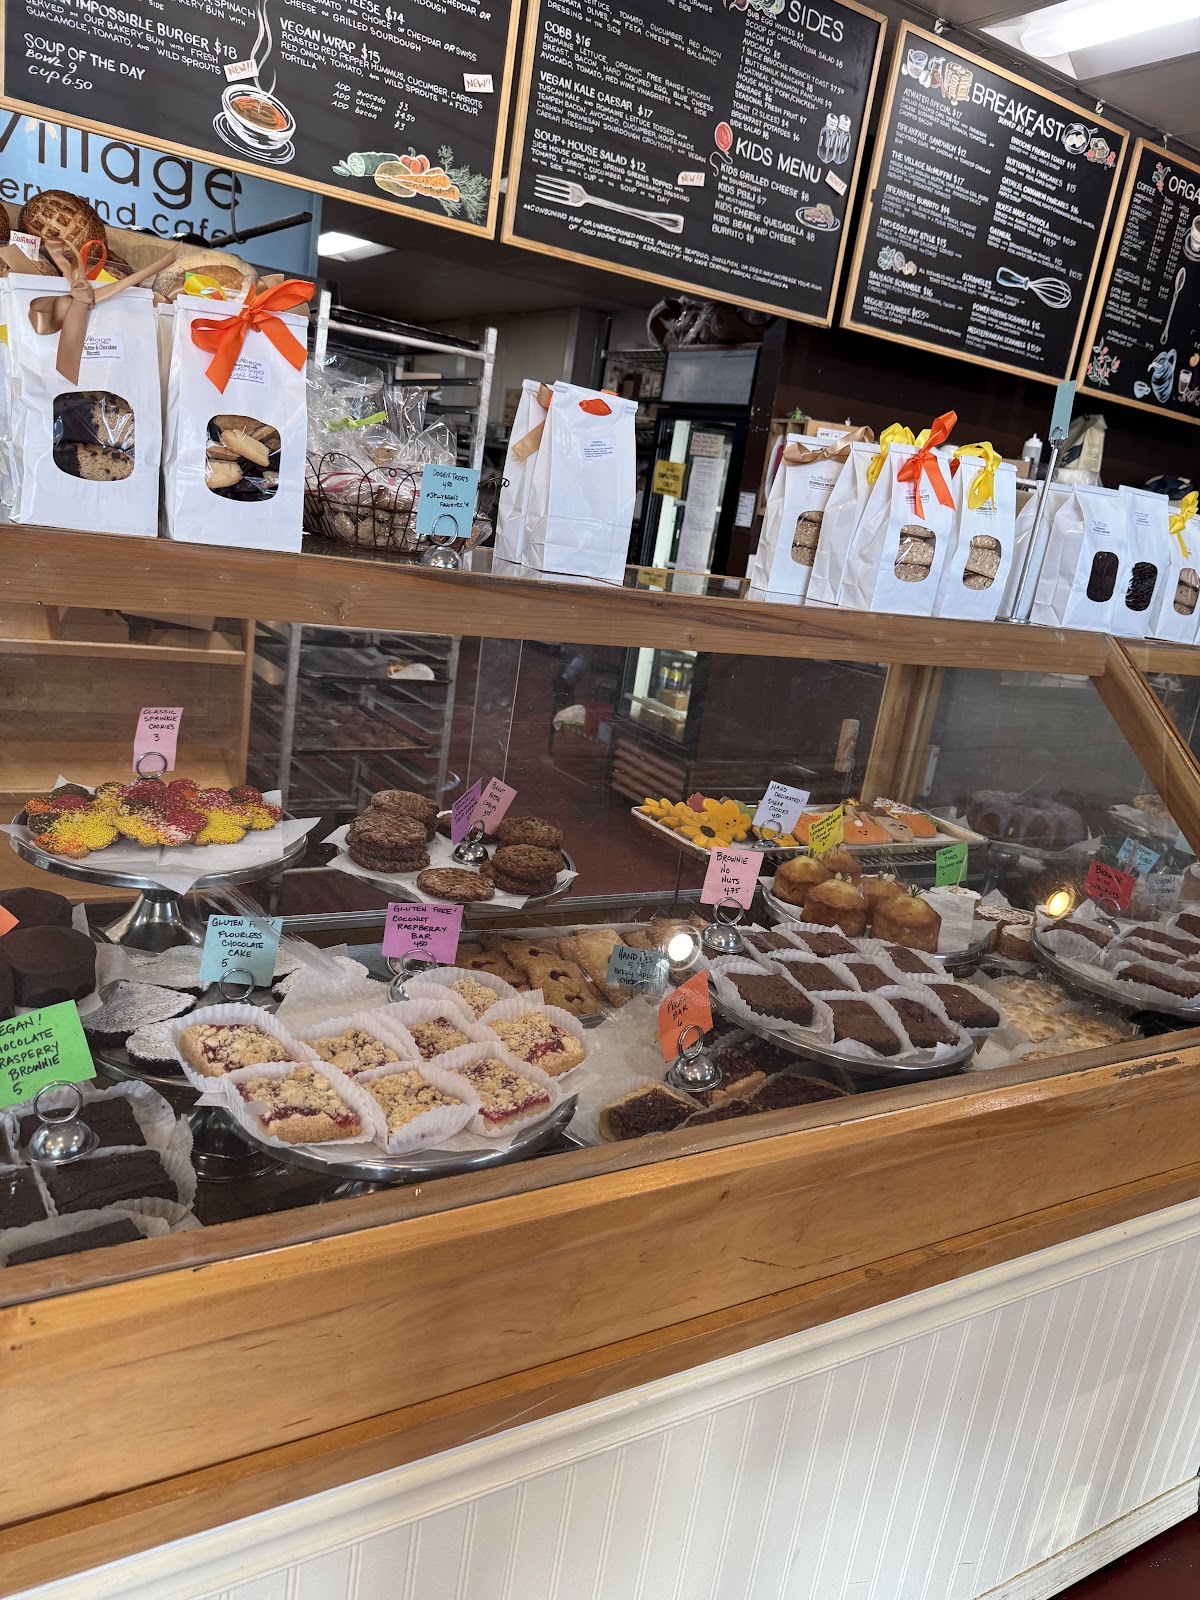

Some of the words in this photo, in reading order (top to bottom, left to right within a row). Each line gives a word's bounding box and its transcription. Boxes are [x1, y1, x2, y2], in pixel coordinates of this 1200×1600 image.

[212, 0, 256, 20] SPINACH
[76, 0, 154, 32] IMPOSSIBLE
[158, 22, 210, 52] BURGER
[214, 37, 238, 60] $18
[788, 0, 844, 42] SIDES
[26, 6, 91, 36] GUACAMOLE,
[92, 26, 134, 48] TOMATO,
[137, 44, 150, 52] AND
[156, 48, 180, 62] WILD
[182, 55, 222, 76] SPROUTS
[84, 14, 104, 28] OUR
[106, 20, 144, 40] BAKERY
[146, 33, 165, 47] BUN
[170, 42, 186, 52] WITH
[191, 48, 219, 64] FRESH
[280, 16, 322, 43] VEGAN
[323, 33, 356, 54] WRAP
[360, 43, 381, 64] $15
[333, 13, 368, 33] GRILLED
[370, 26, 422, 53] SOURDOUGH
[544, 20, 573, 40] COBB
[576, 32, 592, 47] $16
[744, 28, 766, 43] BACON
[766, 36, 774, 47] $5
[24, 32, 66, 56] SOUP
[68, 47, 86, 62] OF
[89, 53, 116, 72] THE
[119, 62, 146, 81] DAY
[280, 50, 318, 70] TORTILLA
[69, 62, 78, 74] 9
[228, 62, 254, 77] NEW!!
[282, 30, 320, 52] ROASTED
[321, 45, 338, 58] RED
[338, 51, 370, 70] PEPPER
[371, 61, 406, 83] HUMMUS,
[408, 74, 450, 99] CUCUMBER,
[450, 91, 483, 110] CARROTS
[62, 73, 93, 91] 6.50
[466, 78, 492, 90] NEW!!
[333, 90, 350, 102] ADD
[356, 97, 384, 114] chicken
[335, 81, 351, 92] ADD
[356, 88, 386, 106] avocado
[398, 101, 410, 112] $3
[540, 71, 573, 93] VEGAN
[574, 82, 596, 99] KALE
[597, 91, 634, 112] CAESAR
[637, 104, 654, 119] $17
[332, 100, 349, 110] ADD
[354, 106, 378, 120] bacon
[394, 120, 406, 132] $3
[972, 82, 1066, 142] BREAKFAST
[998, 116, 1016, 130] SERVED
[1016, 124, 1024, 134] ALL
[1024, 128, 1036, 138] DAY
[567, 138, 598, 159] HOUSE
[599, 148, 628, 166] SALAD
[630, 157, 647, 173] $12
[736, 137, 773, 166] KIDS
[777, 152, 822, 184] MENU
[1032, 146, 1051, 161] FRENCH
[1052, 154, 1066, 167] TOAST
[892, 150, 904, 161] THE
[904, 155, 926, 171] VILLAGE
[954, 174, 966, 186] $17
[720, 162, 738, 176] KIDS
[740, 170, 770, 188] GRILLED
[770, 181, 799, 198] CHEESE
[800, 190, 810, 202] $8
[1136, 181, 1156, 197] COFFEE
[1168, 176, 1200, 205] ORGA
[718, 181, 735, 195] KIDS
[736, 188, 756, 202] PB&J
[756, 194, 768, 206] $7
[713, 213, 730, 226] KIDS
[732, 218, 752, 232] BEAN
[752, 225, 768, 236] AND
[768, 230, 797, 246] CHEESE
[714, 200, 732, 213] KIDS
[733, 207, 762, 222] CHEESE
[763, 216, 804, 237] QUESADILLA
[806, 231, 816, 242] $8
[712, 224, 744, 240] BURRITO
[746, 232, 755, 244] $8
[154, 733, 160, 742] 3
[770, 784, 788, 794] HAND
[774, 792, 805, 805] DECORATED!
[768, 798, 784, 807] SUGAR
[768, 805, 790, 815] COOKIES
[716, 852, 749, 865] BROWNIE
[720, 866, 730, 874] NO
[722, 876, 740, 885] NUTS
[1090, 882, 1119, 899] WALNUTS
[392, 915, 430, 924] COCONUT
[393, 905, 428, 914] GLUTEN
[434, 906, 458, 915] FREE!
[212, 918, 244, 926] GLUTEN
[396, 924, 448, 933] RASPBERRY
[218, 930, 262, 940] FLOURLESS
[222, 940, 264, 949] CHOCOLATE
[411, 932, 432, 940] BAR
[222, 958, 230, 968] 5
[228, 950, 252, 958] CAKE
[618, 948, 638, 961] HAND
[672, 1006, 688, 1020] BAR
[0, 1014, 42, 1036] EGAN!
[8, 1053, 60, 1081] BROWNIE
[13, 1082, 24, 1095] 5
